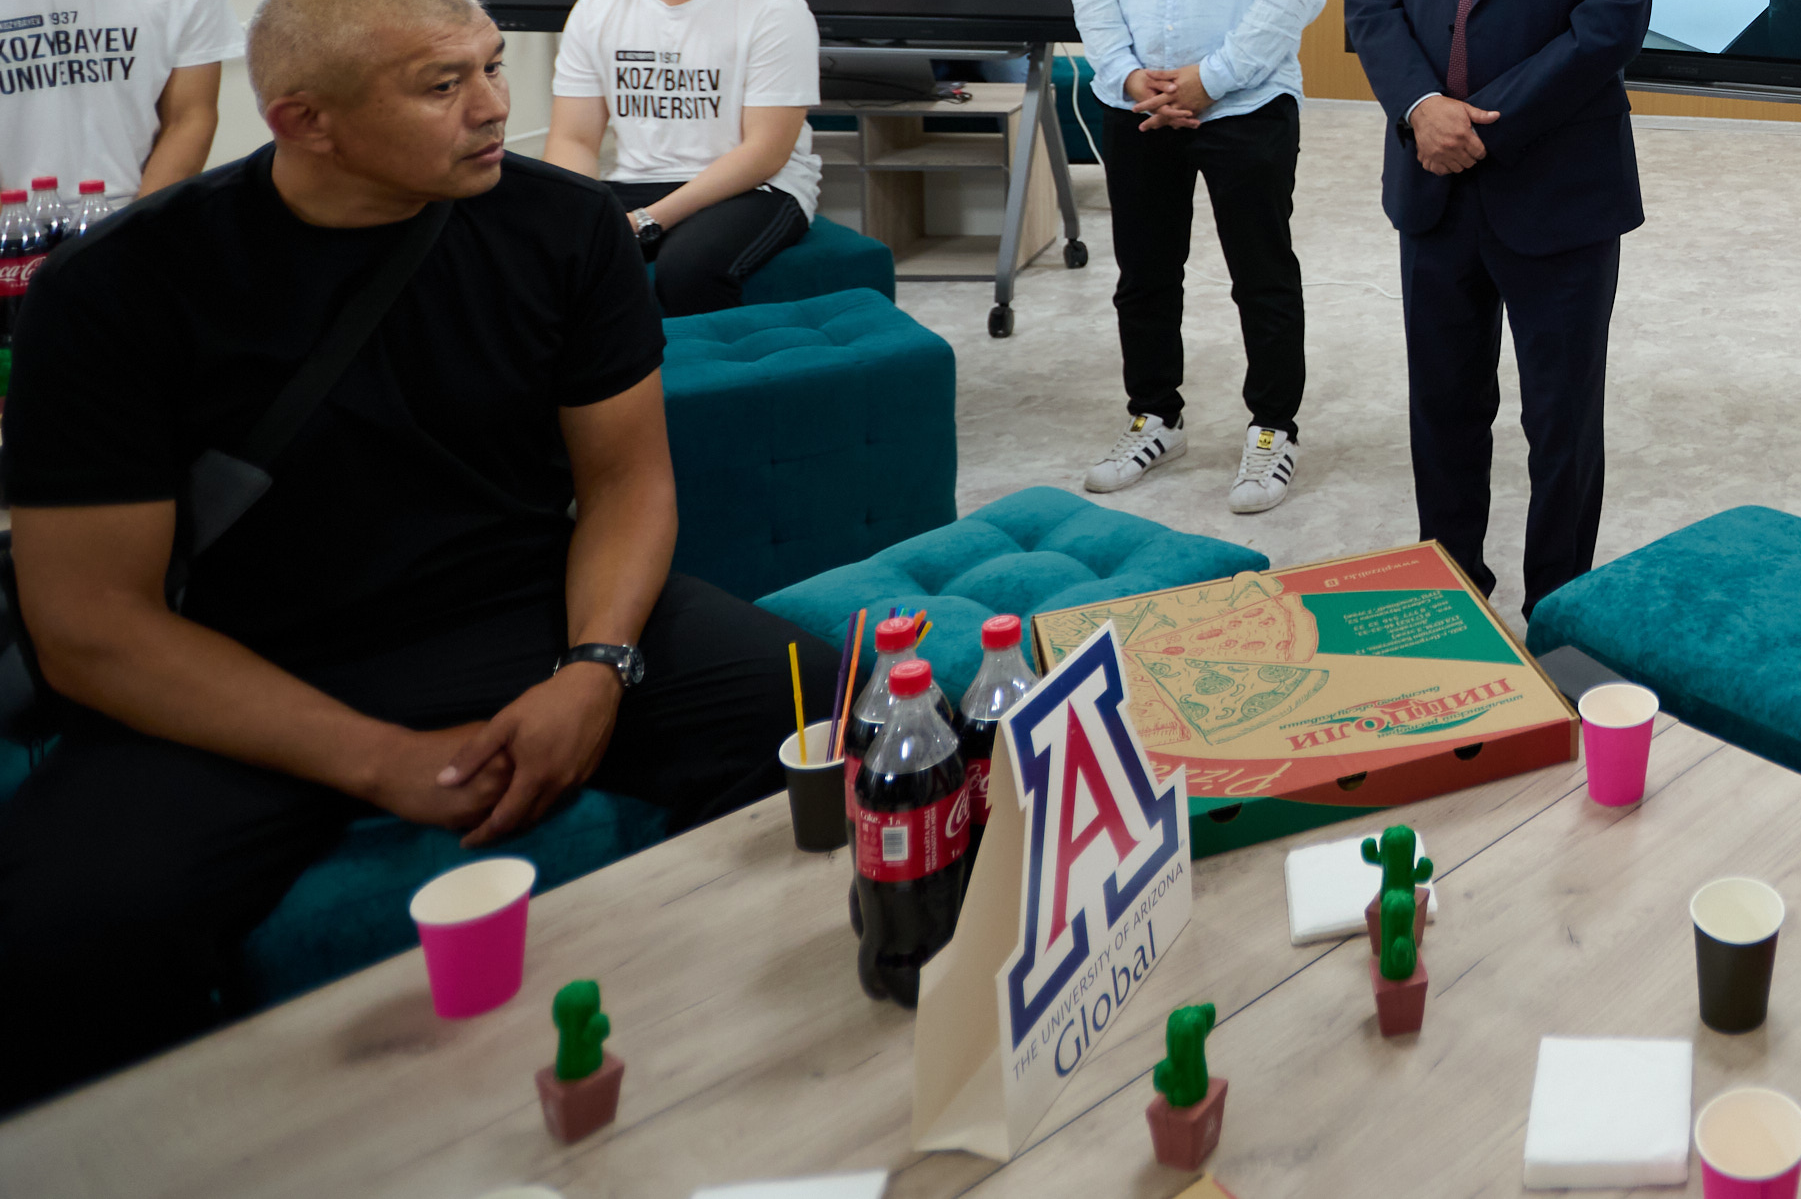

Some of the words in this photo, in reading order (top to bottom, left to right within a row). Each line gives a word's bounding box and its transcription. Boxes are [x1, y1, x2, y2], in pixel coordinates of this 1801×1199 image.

[0, 56, 136, 95] UNIVERSITY
[49, 10, 78, 25] 937
[1285, 678, 1516, 751] ПИЦЦОЛИ
[1008, 630, 1180, 1052] A
[1012, 1040, 1038, 1082] THE
[1042, 945, 1111, 1045] UNIVERSITY
[1115, 923, 1130, 951] OF
[1133, 862, 1183, 930] ARIZONA
[1054, 919, 1157, 1078] Global
